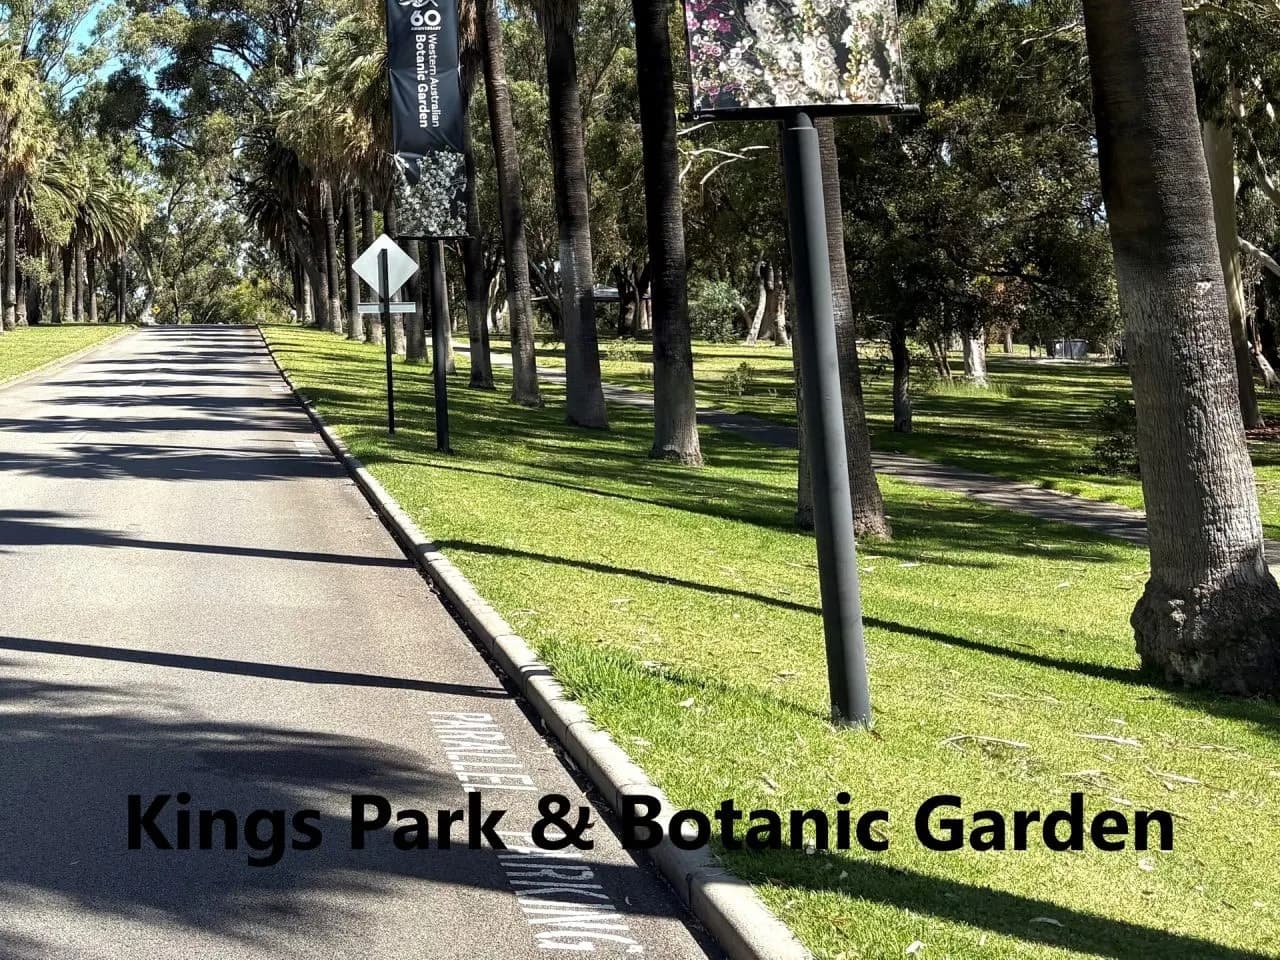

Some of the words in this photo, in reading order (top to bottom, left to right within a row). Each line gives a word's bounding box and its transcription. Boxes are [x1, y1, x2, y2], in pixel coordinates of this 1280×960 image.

[410, 9, 441, 27] 60
[415, 34, 428, 81] Botanic
[428, 34, 438, 76] Western
[418, 84, 431, 128] Garden
[430, 77, 442, 128] Australian
[426, 711, 539, 793] PARALLEL
